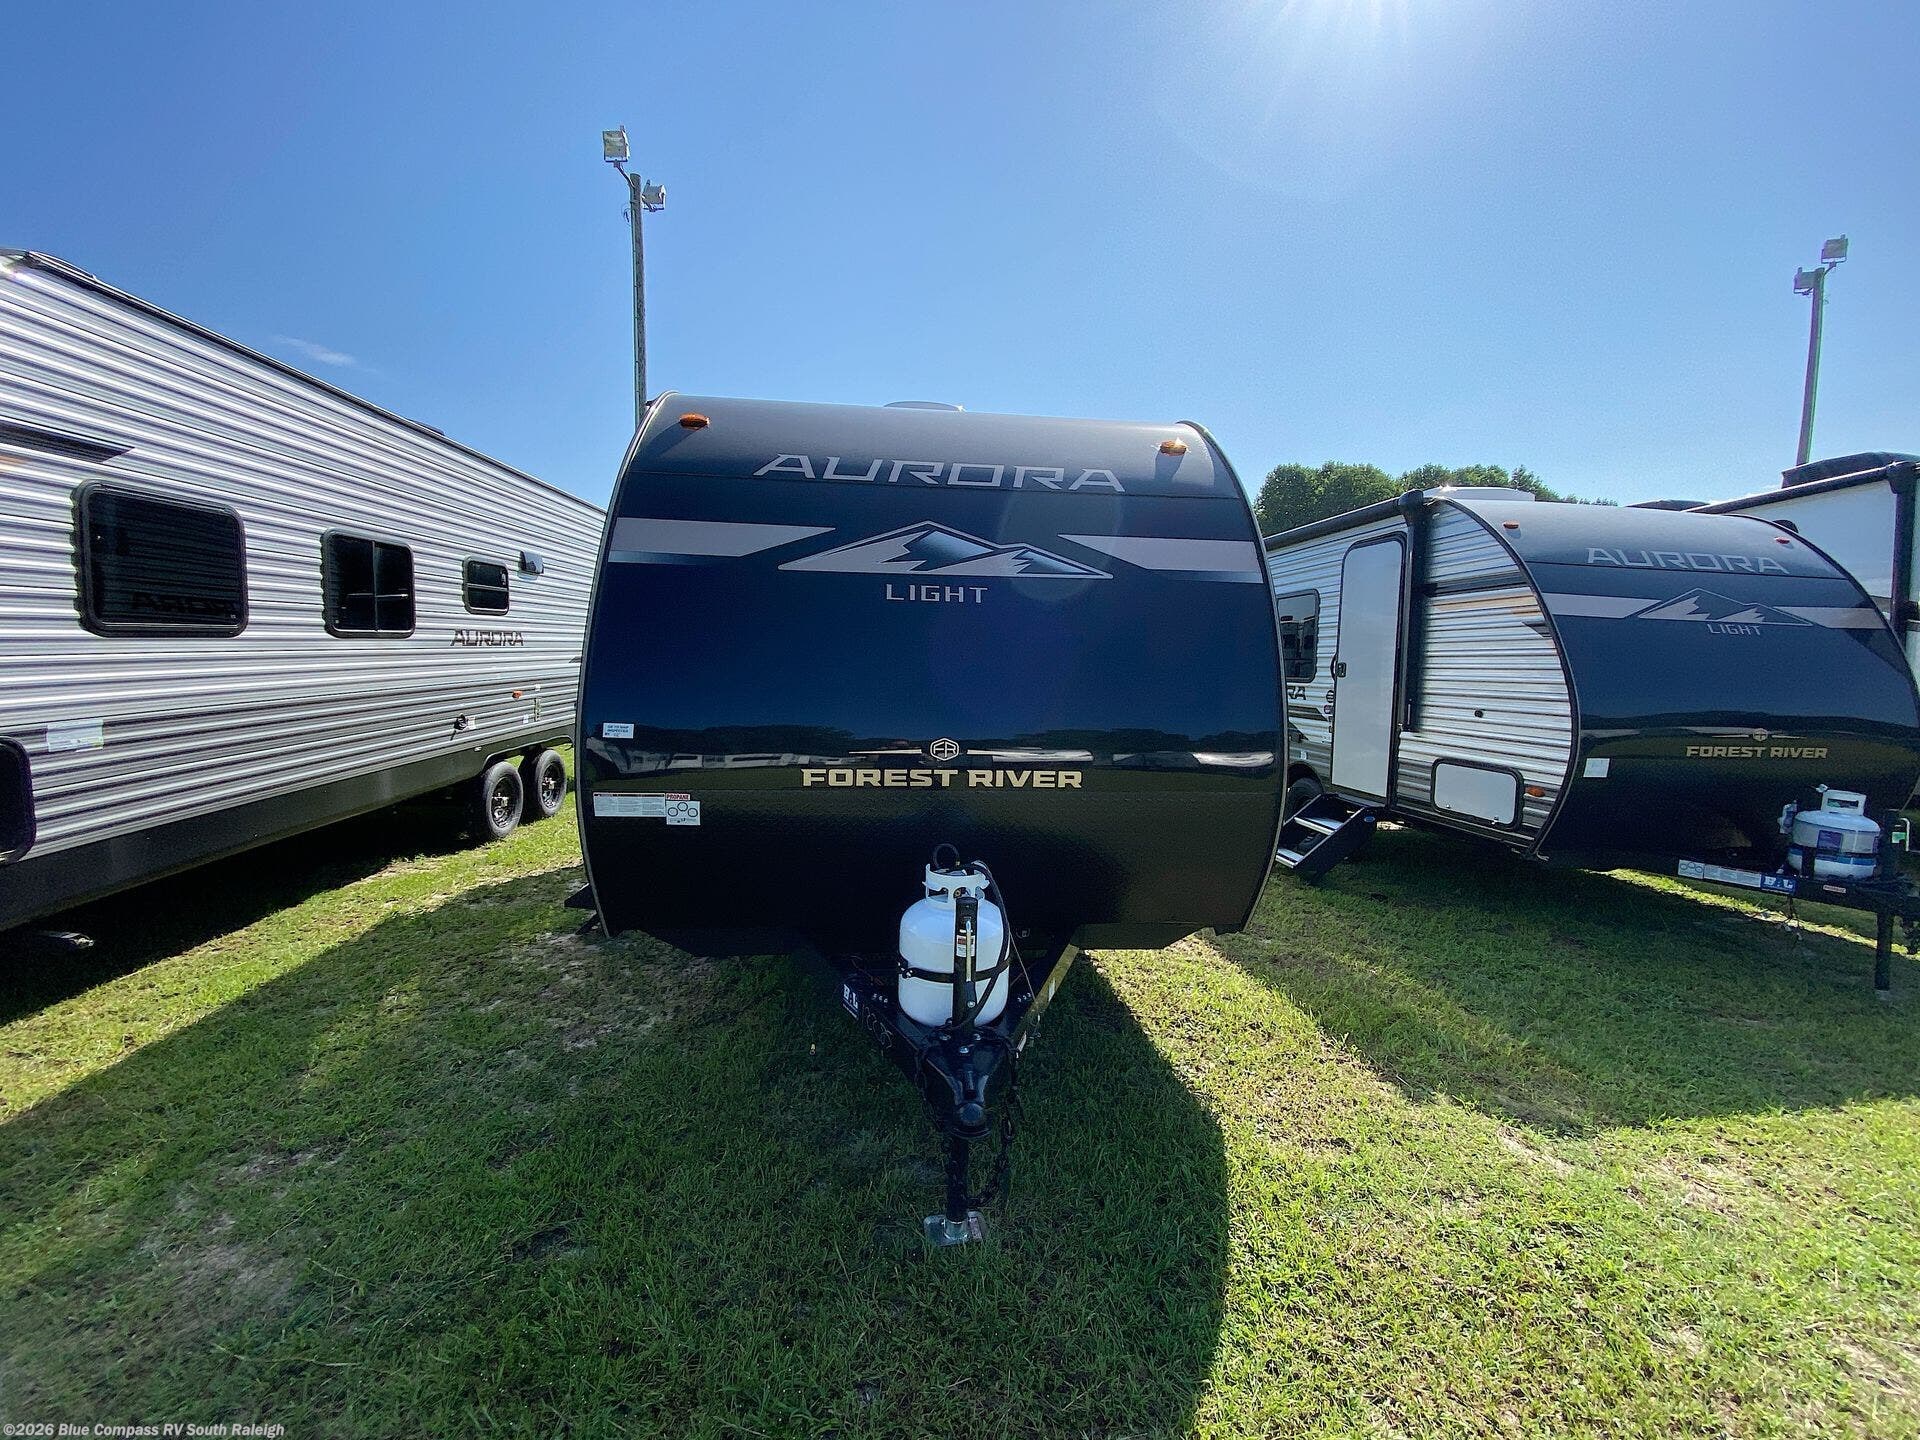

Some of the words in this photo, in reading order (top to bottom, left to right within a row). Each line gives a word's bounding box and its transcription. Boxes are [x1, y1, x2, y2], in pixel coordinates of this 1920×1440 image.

[753, 454, 1126, 492] AURORA
[1587, 547, 1790, 575] AURORA
[886, 583, 989, 604] LIGHT
[450, 628, 524, 646] AURORA
[1707, 623, 1761, 636] LIGHT
[1686, 746, 1766, 758] FOREST
[1770, 747, 1828, 759] RIVER
[801, 768, 959, 787] FOREST
[967, 770, 1083, 788] RIVER
